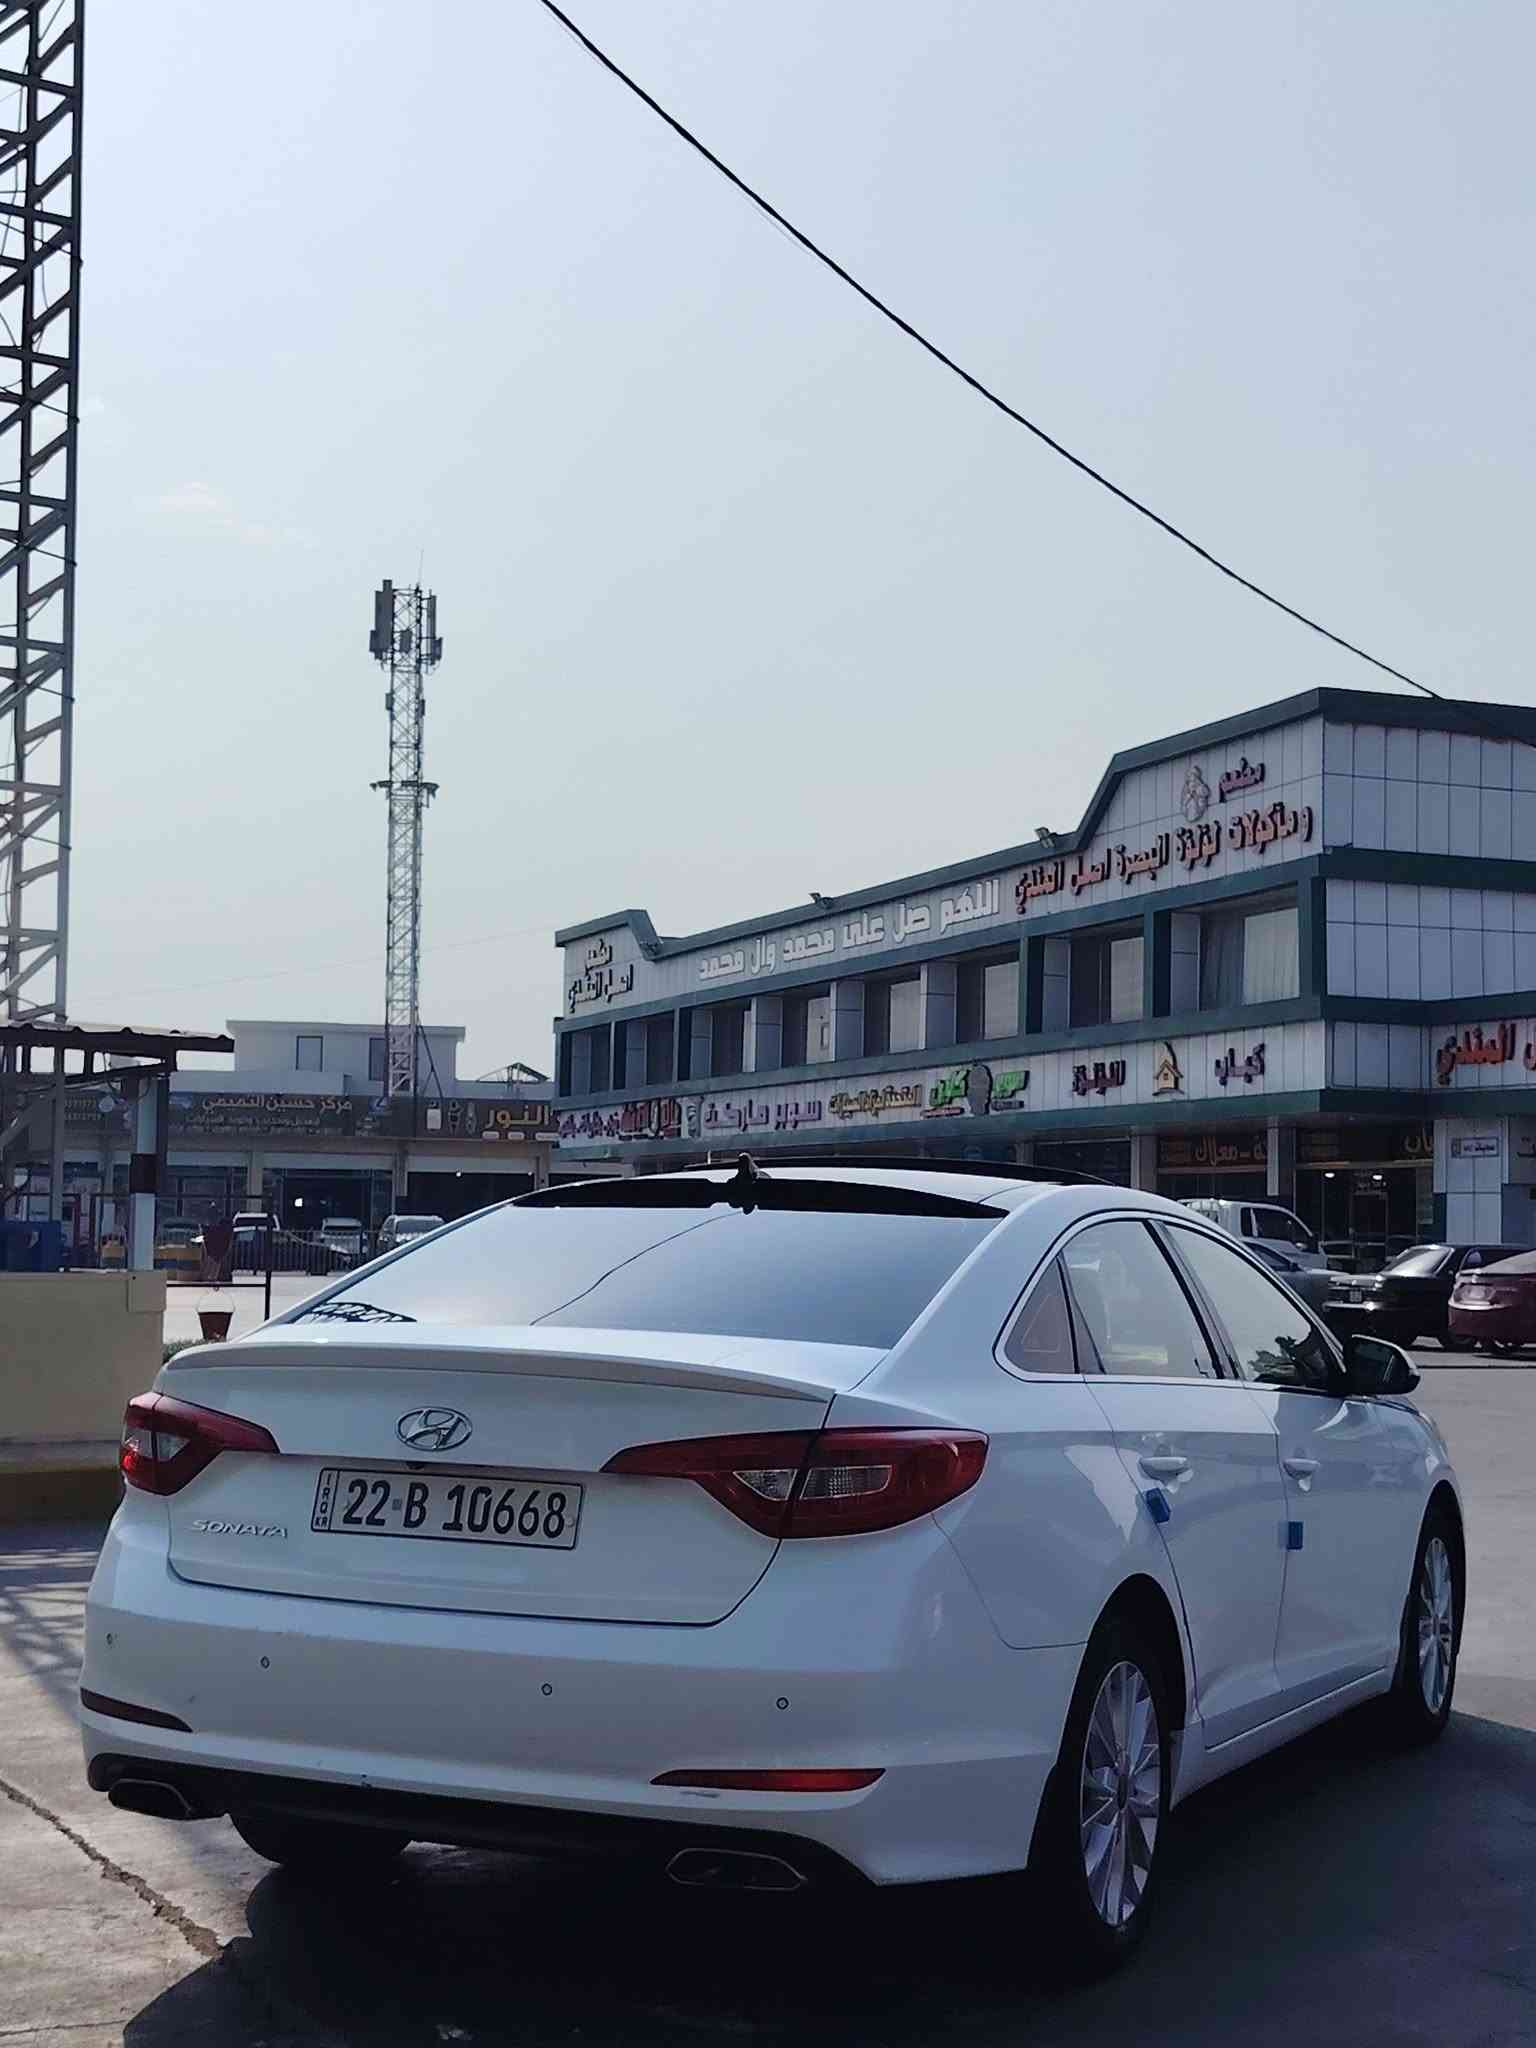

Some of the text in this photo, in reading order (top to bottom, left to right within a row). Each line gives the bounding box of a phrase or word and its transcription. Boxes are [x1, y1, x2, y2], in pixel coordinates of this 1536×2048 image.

[1114, 832, 1170, 885] البصرة
[893, 903, 931, 943] صل
[940, 878, 1000, 933] اللهم
[783, 927, 835, 965] محمد
[698, 948, 746, 981] محمد
[1214, 1043, 1265, 1087] كباب
[266, 1095, 315, 1113] حسين
[319, 1095, 353, 1114] مركز
[484, 1104, 549, 1129] النور
[774, 1100, 822, 1130] سوبر
[343, 1479, 566, 1539] 22 B 10668
[189, 1519, 288, 1538] SONATA
